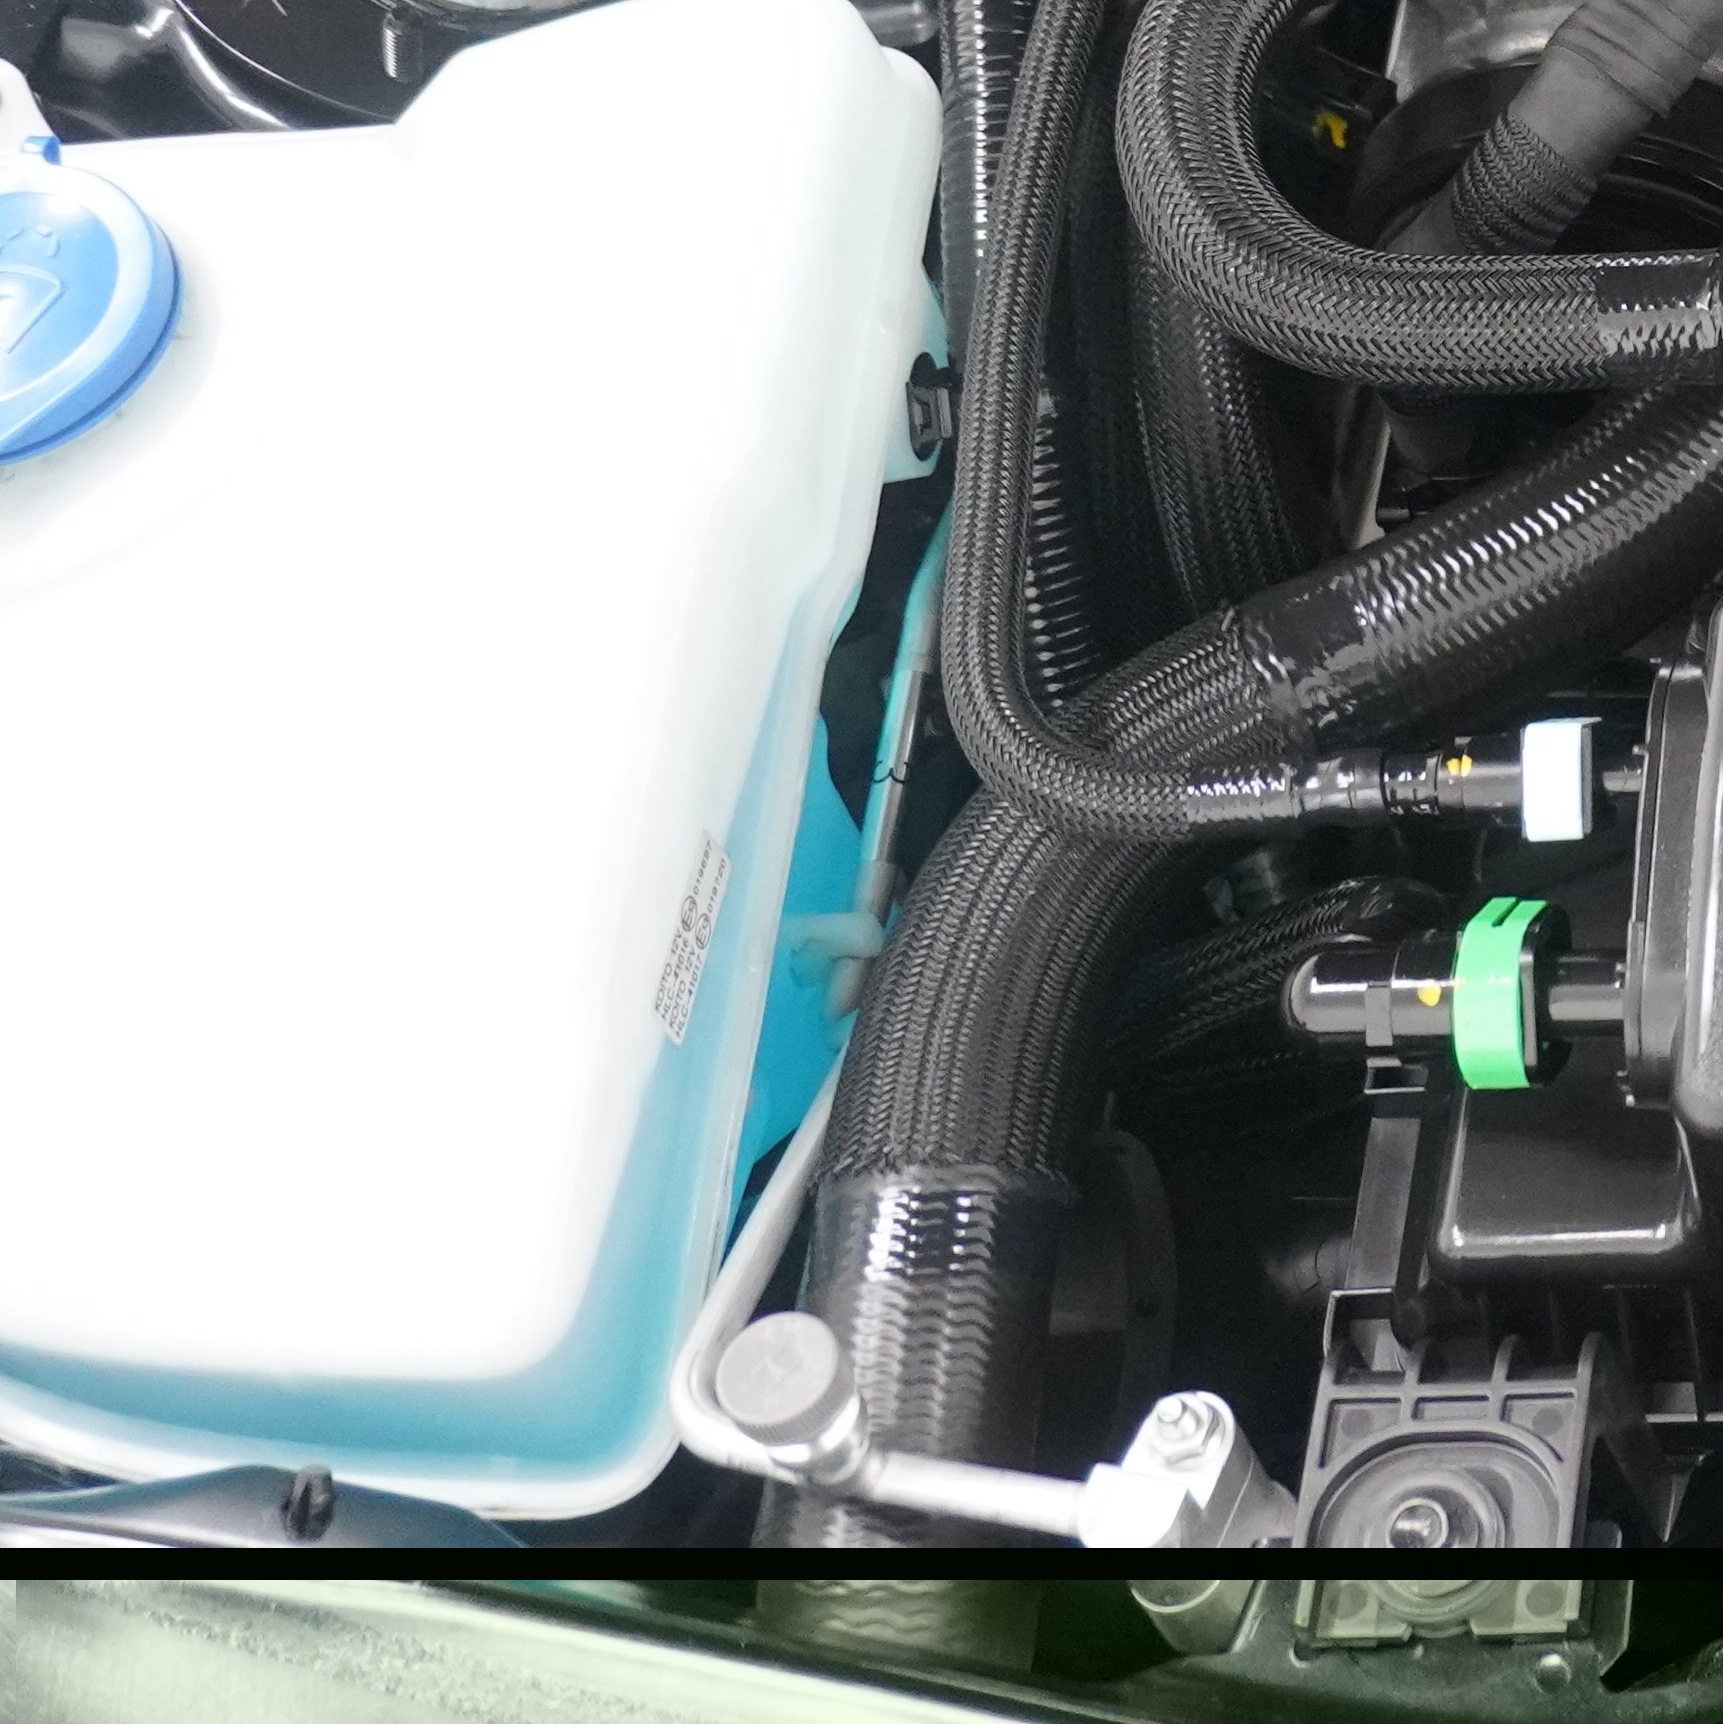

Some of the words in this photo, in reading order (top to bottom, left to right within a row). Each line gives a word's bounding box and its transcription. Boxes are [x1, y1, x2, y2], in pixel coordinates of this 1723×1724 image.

[655, 962, 673, 1011] KOITO
[670, 927, 682, 956] 12V
[669, 980, 686, 1028] KOITO
[684, 945, 697, 973] 12V
